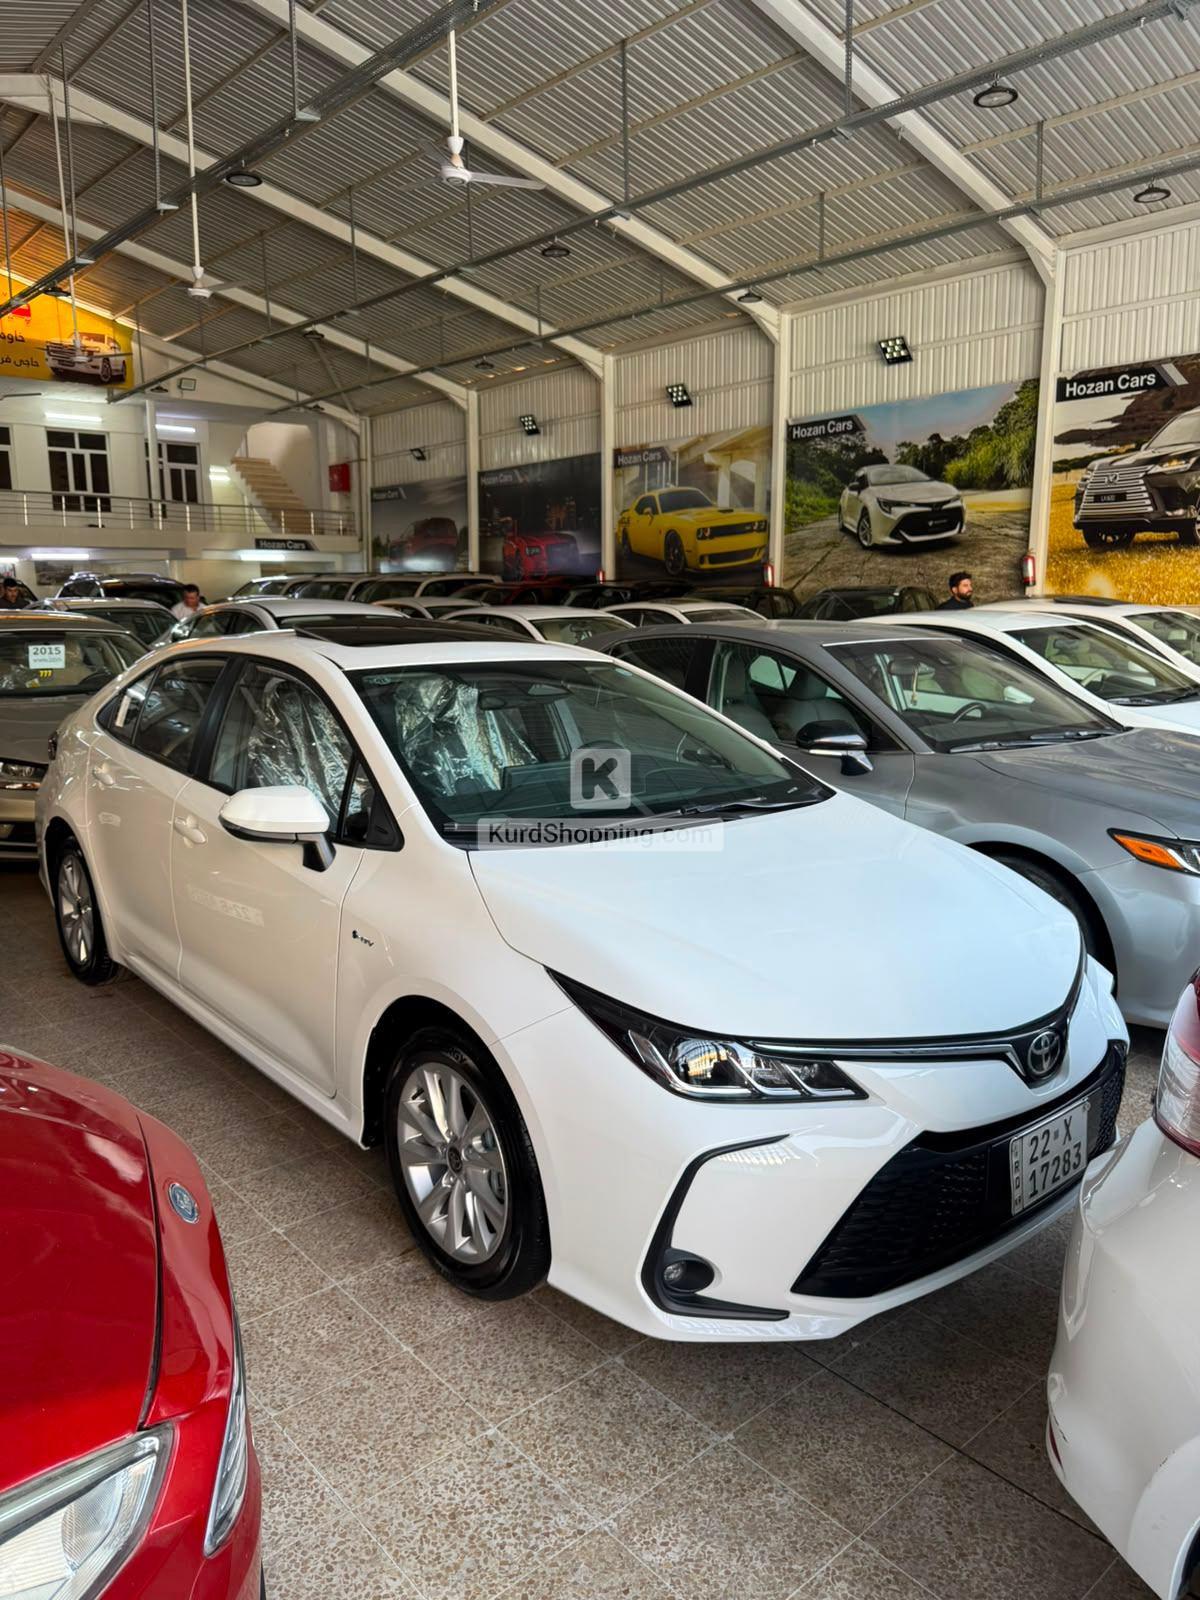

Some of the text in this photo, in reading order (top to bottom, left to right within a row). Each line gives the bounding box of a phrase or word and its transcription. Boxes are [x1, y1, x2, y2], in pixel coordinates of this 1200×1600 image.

[1065, 374, 1156, 398] Hozan Cars
[792, 420, 853, 439] Hozan Cars
[642, 451, 662, 462] Cars
[287, 540, 305, 549] Cars
[33, 647, 61, 655] 2015
[1029, 1115, 1073, 1164] 22 X
[1028, 1141, 1082, 1199] 17283
